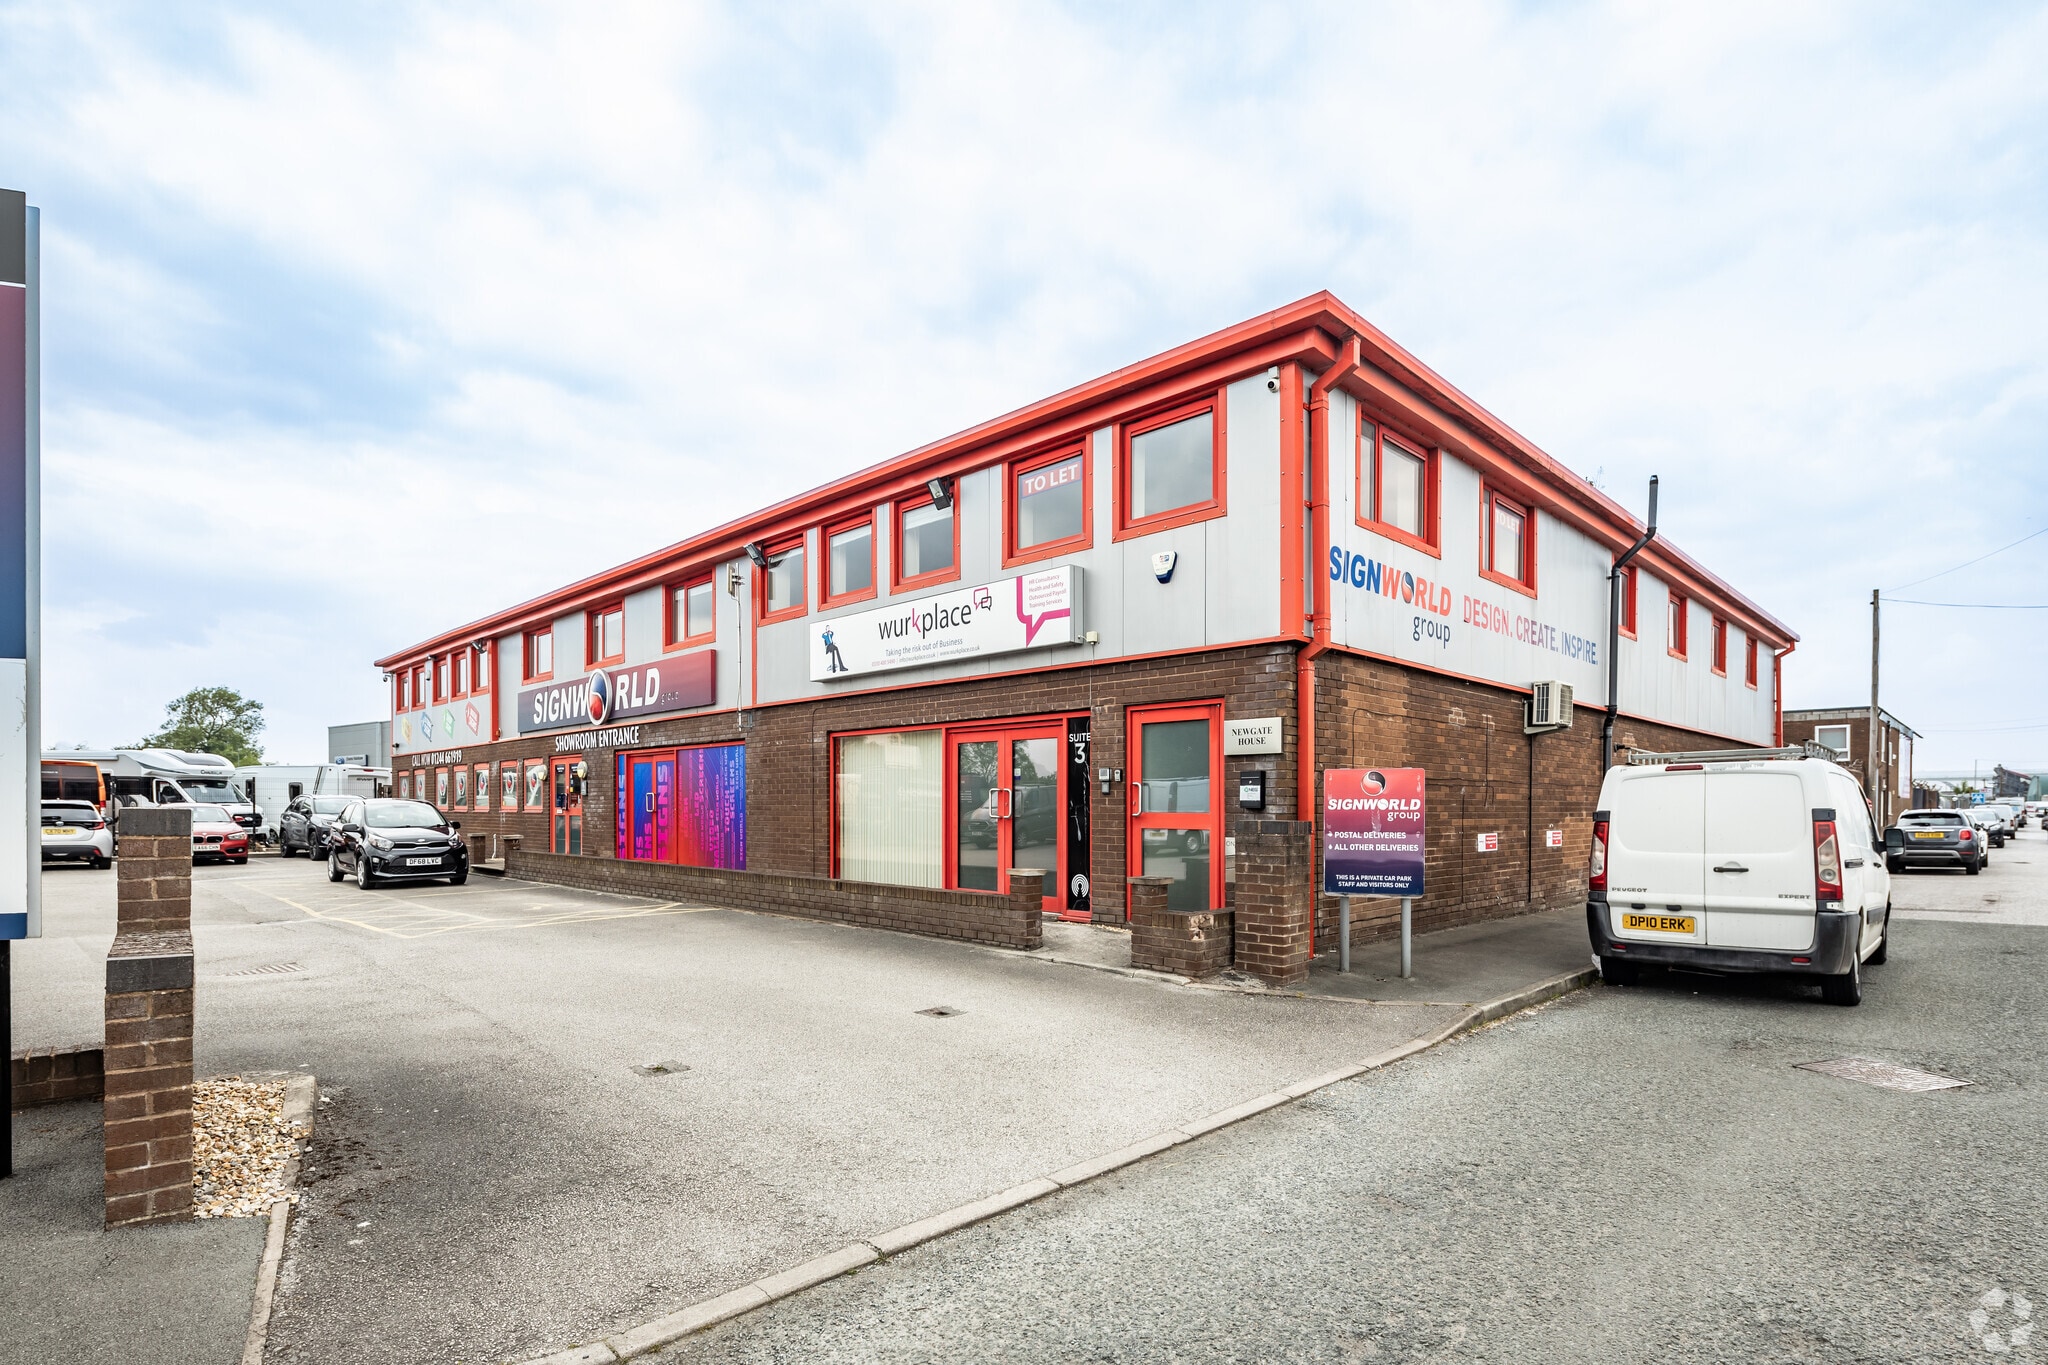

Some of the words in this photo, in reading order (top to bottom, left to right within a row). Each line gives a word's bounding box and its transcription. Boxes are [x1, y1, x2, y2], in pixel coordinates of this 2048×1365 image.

[1024, 475, 1046, 494] TO
[1050, 464, 1079, 487] LET
[1495, 508, 1507, 525] TO
[1507, 513, 1520, 532] LET
[1035, 575, 1060, 583] Consultancy
[1029, 592, 1052, 600] Outsourced
[1052, 588, 1067, 596] Payroll
[1046, 598, 1063, 606] Services
[878, 602, 972, 640] wurkplace
[1412, 615, 1451, 649] group
[1463, 594, 1513, 637] DESIGN.
[1516, 615, 1559, 653] CREATE.
[1561, 631, 1599, 666] INSPIRE.
[885, 648, 901, 657] Taking
[902, 645, 911, 654] the
[912, 643, 921, 652] risk
[922, 643, 932, 651] out
[932, 640, 939, 649] of
[939, 637, 963, 649] Business
[1231, 726, 1273, 736] NEWGATE
[555, 732, 597, 752] SHOWROOM
[599, 725, 640, 748] ENTRANCE
[1068, 732, 1091, 744] SUITE
[1238, 736, 1266, 746] HOUSE
[1074, 743, 1086, 764] 3
[411, 754, 421, 767] CALL
[1327, 798, 1421, 811] SIGNWORLD
[1387, 811, 1421, 822] group
[1334, 831, 1362, 839] POSTAL
[1363, 831, 1407, 839] DELIVERIES
[1334, 843, 1349, 851] ALL
[1349, 843, 1375, 851] OTHER
[1375, 843, 1419, 852] DELIVERIES
[1630, 915, 1657, 928] DP10
[1660, 917, 1686, 930] ERK
